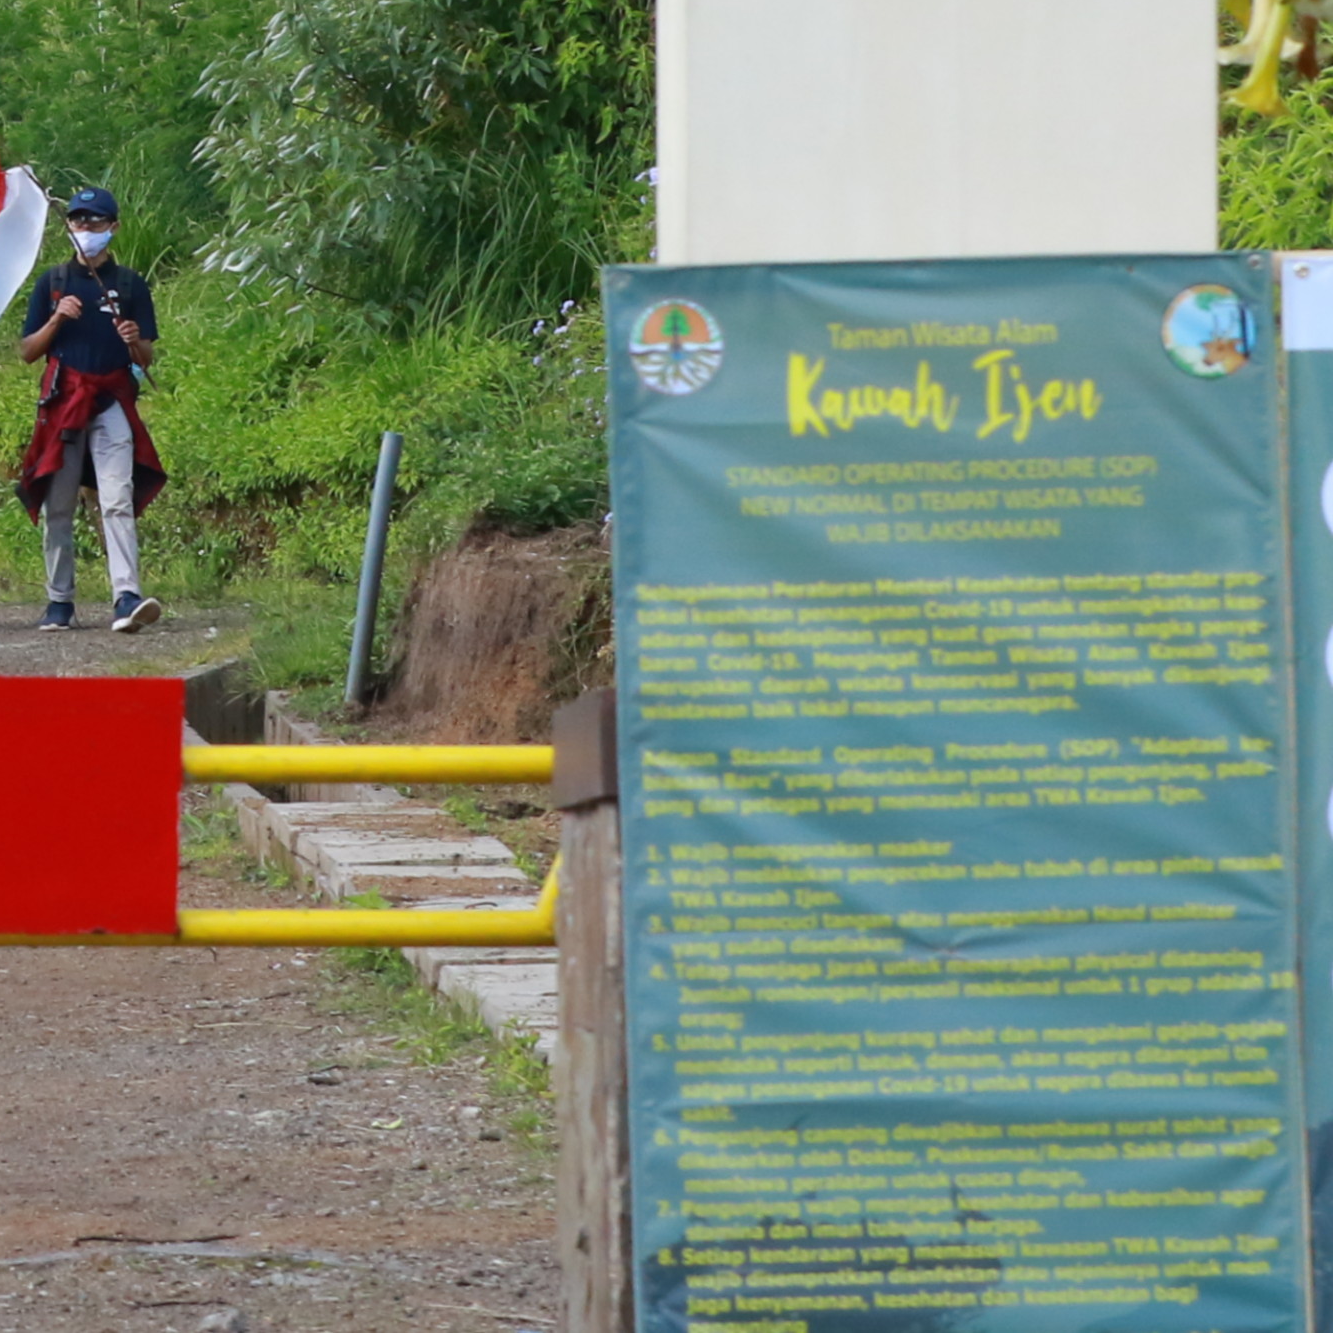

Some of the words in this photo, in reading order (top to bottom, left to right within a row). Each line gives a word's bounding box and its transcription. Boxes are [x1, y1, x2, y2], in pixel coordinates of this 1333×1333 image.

[827, 323, 910, 351] Taman
[913, 322, 993, 348] Wisata
[997, 320, 1058, 345] Alam
[786, 351, 961, 439] Kawah
[972, 348, 1104, 443] Ijen
[725, 465, 840, 489] STANDARD
[843, 460, 965, 486] OPERATING
[967, 457, 1097, 481] PROCEDURE
[741, 495, 791, 518] NEW
[794, 494, 889, 516] NORMAL
[918, 489, 1002, 513] TEMPAT
[1003, 487, 1084, 511] WISATA
[1083, 485, 1144, 508] YANG
